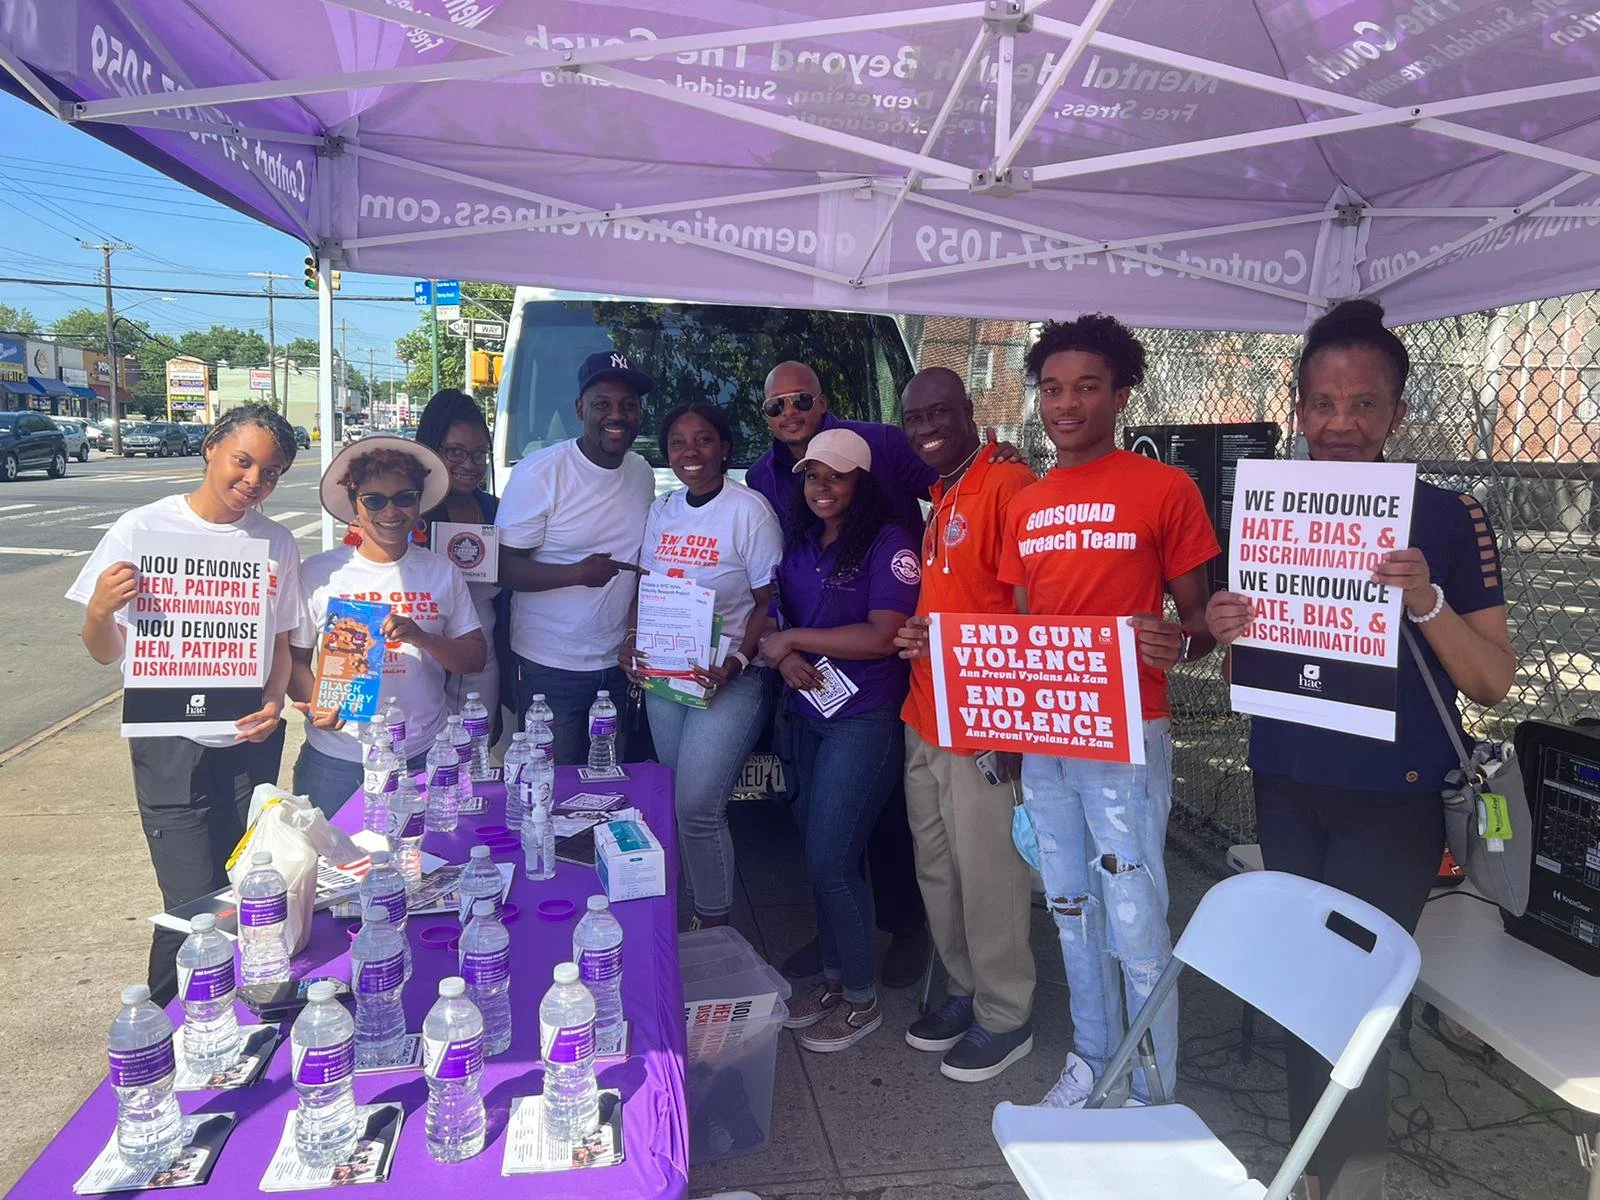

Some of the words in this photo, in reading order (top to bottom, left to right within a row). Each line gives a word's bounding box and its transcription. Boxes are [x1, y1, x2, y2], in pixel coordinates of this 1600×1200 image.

[481, 325, 499, 333] WAY
[610, 353, 628, 369] NY
[1244, 490, 1275, 512] WE
[1282, 491, 1400, 518] DENOUNCE
[1026, 503, 1116, 532] GODSQUAD
[687, 535, 718, 548] GUN
[1018, 530, 1076, 558] utreach
[1081, 528, 1137, 551] Team
[1241, 517, 1300, 543] HATE,
[1308, 520, 1367, 549] BIAS,
[1376, 527, 1395, 549] &
[141, 555, 177, 574] NOU
[185, 559, 260, 579] DENONSE
[139, 576, 178, 597] HEN,
[185, 579, 249, 599] PATIPRI
[252, 582, 260, 598] E
[389, 592, 432, 602] GUN
[1239, 570, 1268, 592] WE
[1275, 574, 1389, 604] DENOUNCE
[137, 597, 260, 616] DISKRIMINASYON
[391, 602, 439, 613] ENCE
[1247, 597, 1295, 625] ATE,
[1303, 603, 1359, 633] BIAS,
[1368, 612, 1387, 634] &
[136, 619, 174, 638] NOU
[181, 620, 258, 639] DENONSE
[959, 624, 1019, 645] END
[1028, 625, 1092, 648] GUN
[135, 640, 174, 659] HEN,
[182, 641, 245, 659] PATIPRI
[250, 642, 257, 659] E
[952, 646, 1107, 673] VIOLENCE
[133, 661, 257, 677] DISKRIMINASYON
[959, 668, 980, 678] Ann
[981, 668, 1016, 679] Prevni
[1018, 669, 1062, 683] Vyolans
[1064, 671, 1080, 682] Ak
[1082, 674, 1108, 684] Zam
[320, 680, 361, 693] BLACK
[1299, 673, 1322, 689] hac
[316, 699, 363, 712] MONTH
[318, 689, 373, 704] HISTORY
[965, 685, 1025, 707] END
[1035, 688, 1100, 712] GUN
[185, 704, 206, 714] hac
[959, 706, 1114, 738] VIOLENCE
[965, 728, 986, 738] Ann
[987, 729, 1022, 740] Prevni
[1023, 732, 1069, 745] Vyolans
[1070, 735, 1086, 745] Ak
[1088, 738, 1114, 749] Zam
[731, 1001, 752, 1022] NOU
